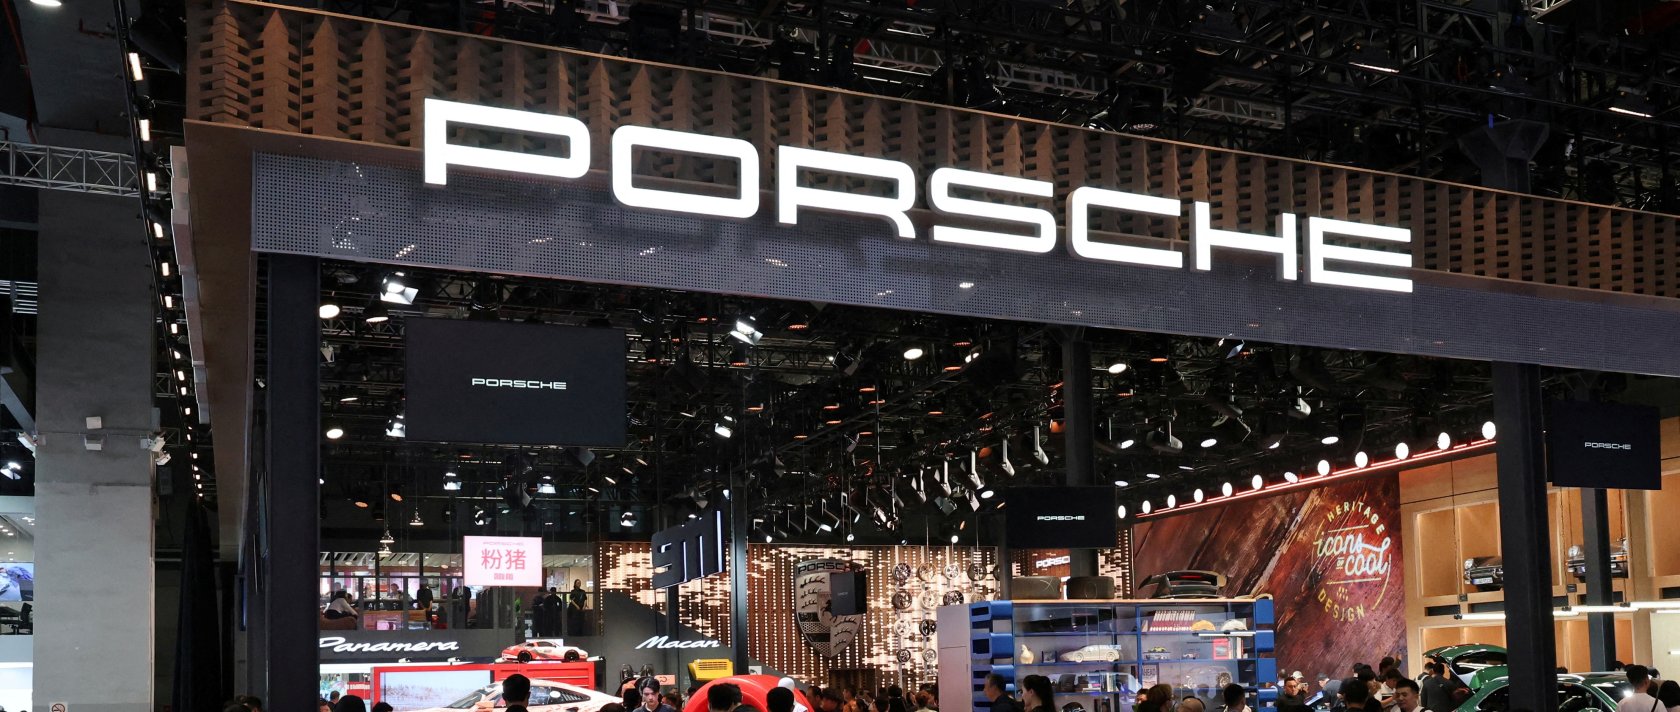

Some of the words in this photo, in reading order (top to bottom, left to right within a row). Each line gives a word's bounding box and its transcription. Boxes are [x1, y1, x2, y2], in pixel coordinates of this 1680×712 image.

[424, 98, 1413, 293] PORSCHE
[471, 378, 567, 390] PORSCHE
[1584, 442, 1631, 450] PORSCHE
[1327, 501, 1385, 535] HERITAGE
[1313, 531, 1364, 557] icons
[481, 548, 527, 570] 粉猪
[1036, 555, 1071, 568] PORSC
[1344, 537, 1391, 576] cool
[1318, 588, 1365, 621] DESIGN
[319, 636, 460, 652] Panamera
[635, 635, 720, 649] Macan
